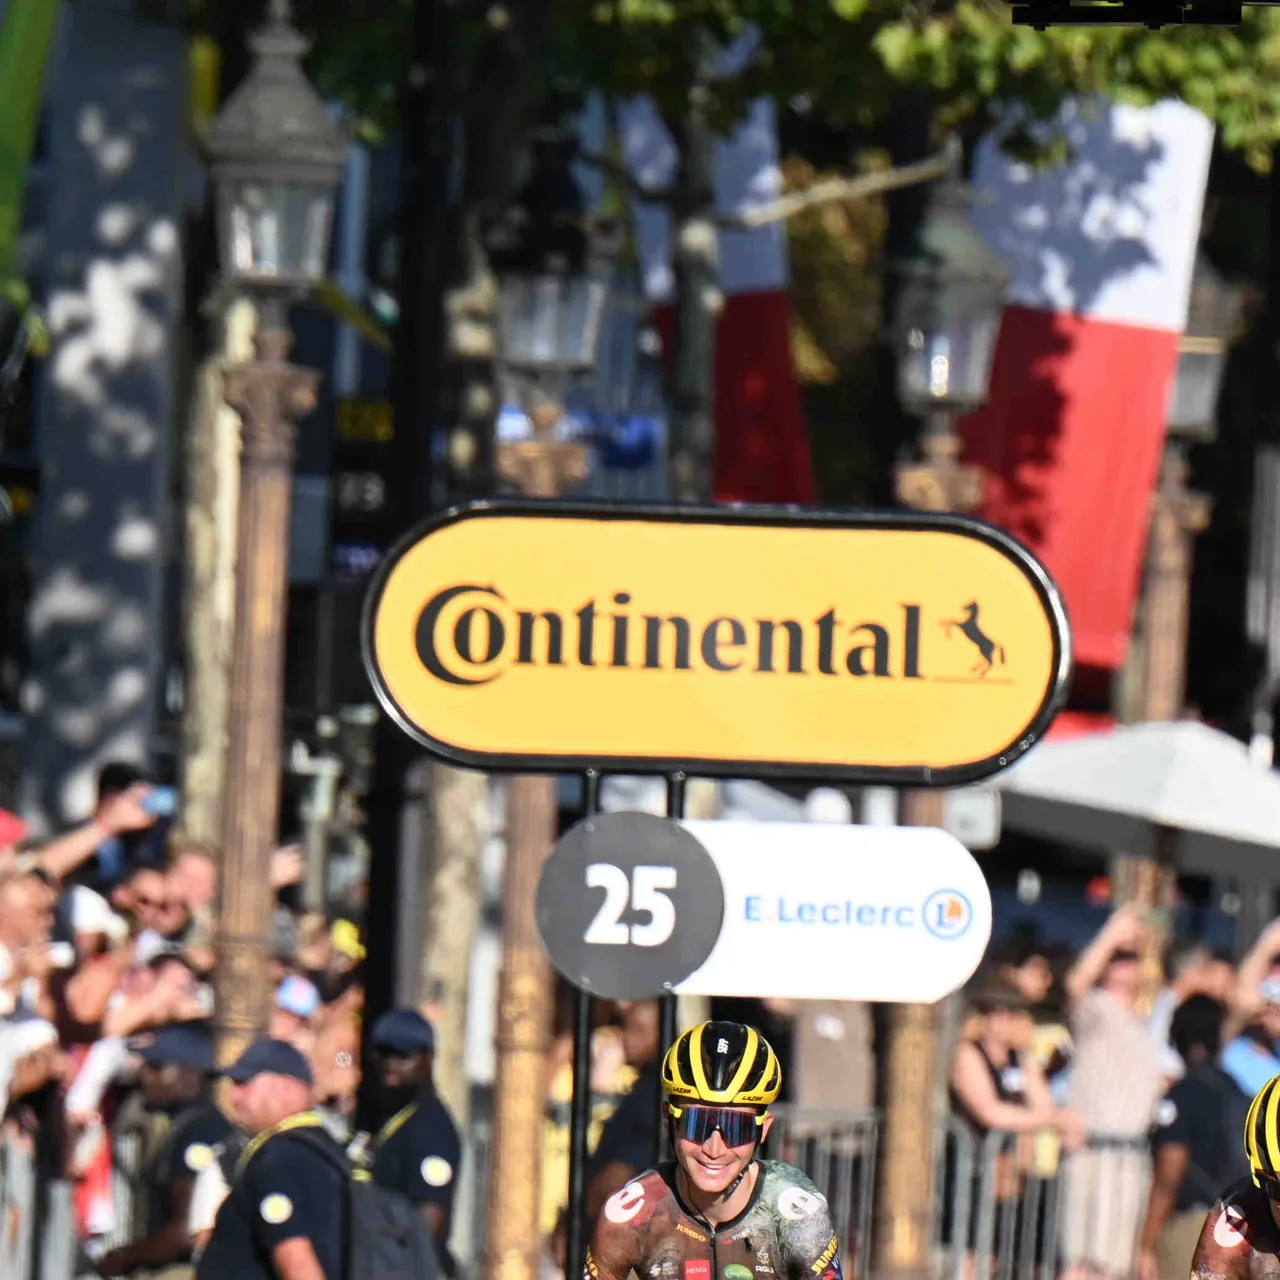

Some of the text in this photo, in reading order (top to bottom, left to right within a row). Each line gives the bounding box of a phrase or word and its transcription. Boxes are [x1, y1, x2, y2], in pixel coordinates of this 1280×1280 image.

[414, 583, 925, 686] Continental
[584, 864, 678, 947] 25
[676, 1223, 706, 1242] JUMBO
